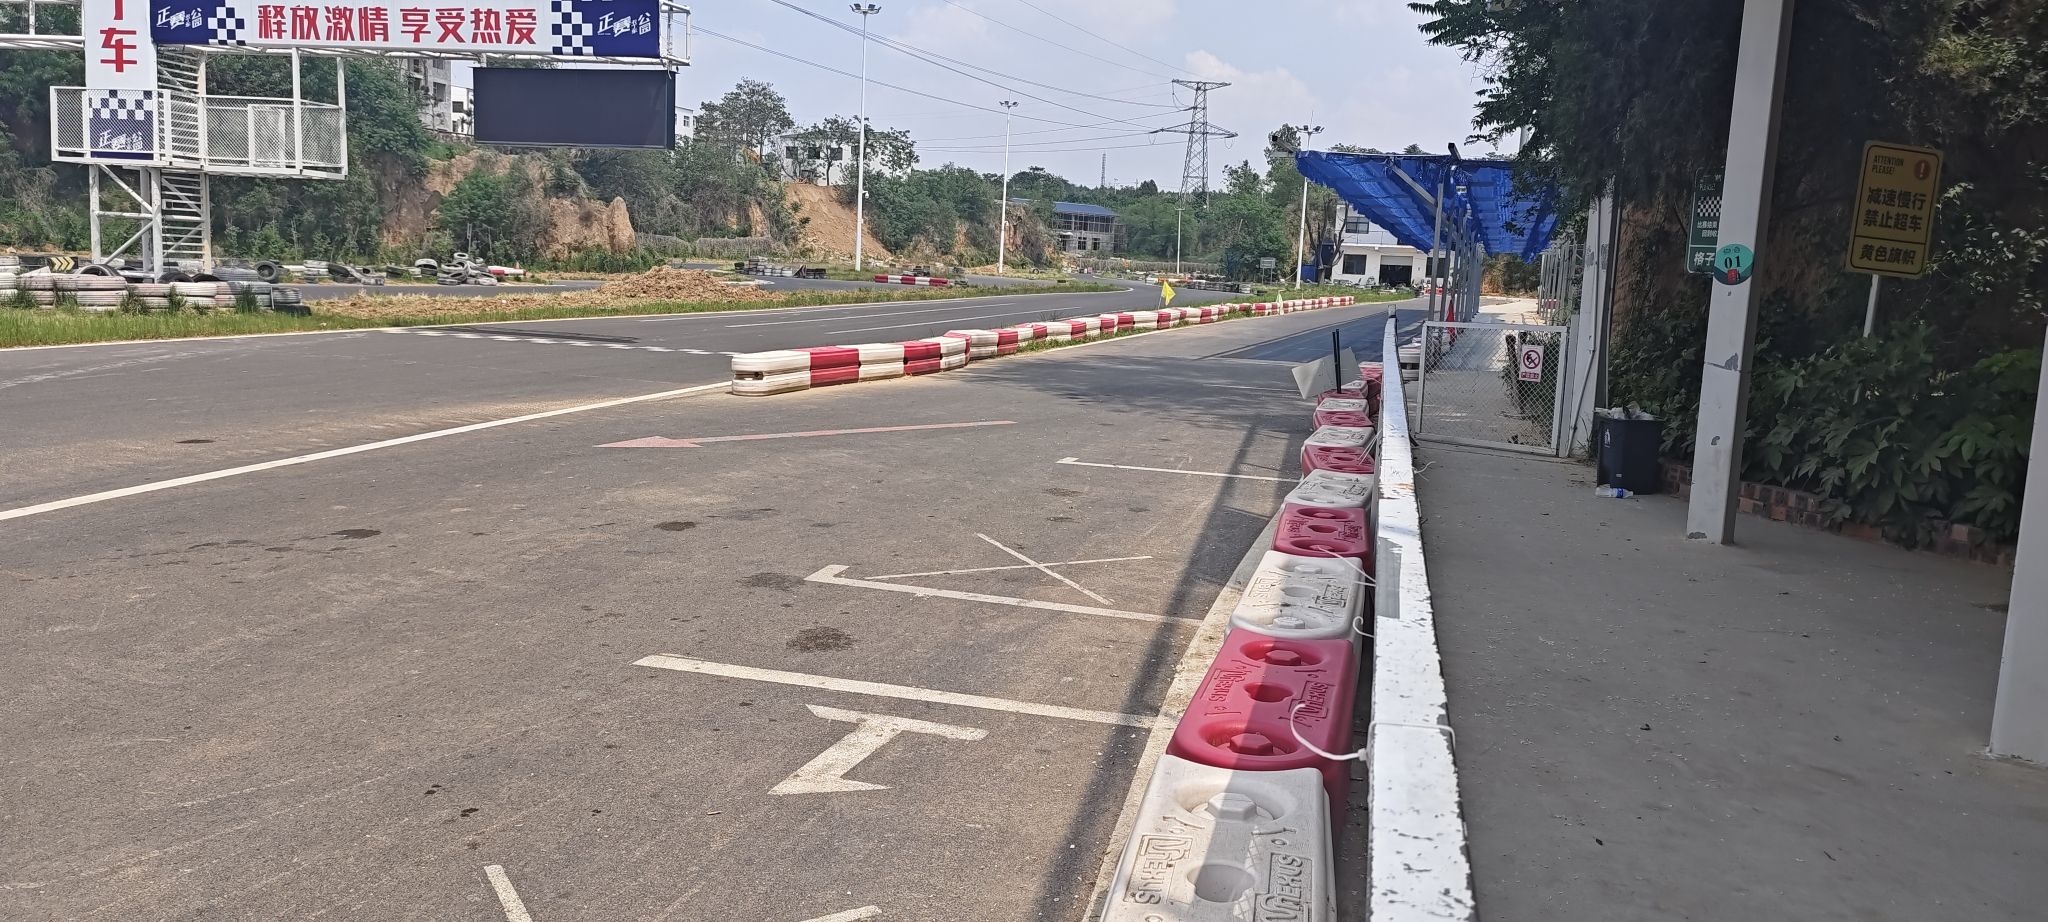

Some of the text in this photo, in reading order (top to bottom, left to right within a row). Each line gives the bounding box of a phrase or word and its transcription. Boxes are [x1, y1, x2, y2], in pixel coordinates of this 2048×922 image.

[257, 5, 537, 45] 释放激情 享受热爱
[1866, 186, 1927, 211] 减速慢行
[1863, 209, 1923, 232] 禁止超车
[1724, 255, 1742, 269] 01
[1859, 244, 1917, 265] 黄色旗帜
